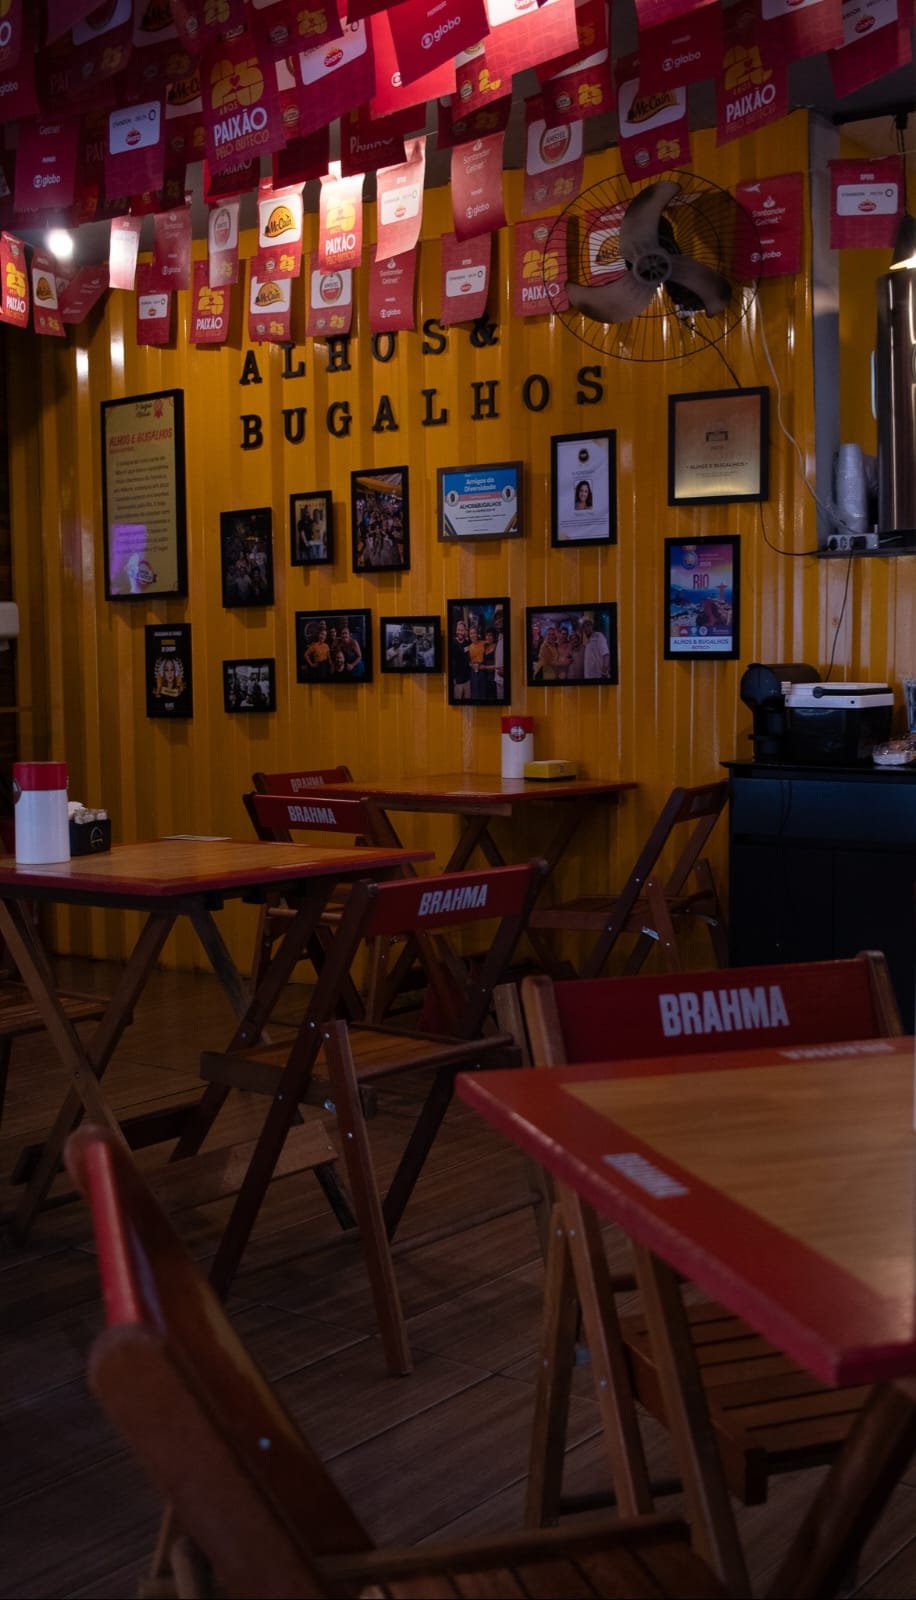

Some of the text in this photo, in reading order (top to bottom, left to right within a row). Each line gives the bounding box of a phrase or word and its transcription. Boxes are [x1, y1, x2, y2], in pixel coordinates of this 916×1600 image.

[433, 16, 461, 42] globo
[673, 51, 702, 68] globo
[208, 57, 264, 110] 25
[577, 83, 604, 107] 25
[635, 93, 672, 115] McCain
[726, 84, 776, 123] PAIXÃO
[213, 107, 268, 147] PAIXÃO
[463, 149, 491, 164] Santander
[655, 138, 681, 162] 25
[42, 173, 61, 188] globo
[553, 178, 574, 197] 25
[473, 203, 490, 217] globo
[751, 208, 784, 218] Santander
[269, 217, 292, 234] McCain
[325, 234, 356, 255] PAIXÃO
[279, 254, 295, 272] 25
[522, 249, 560, 281] 25
[761, 251, 780, 262] globo
[5, 261, 26, 297] 25
[197, 286, 225, 315] 25
[260, 289, 283, 304] McCain
[521, 283, 560, 302] PAIXÃO
[6, 296, 26, 313] PAIXÃO
[196, 315, 223, 331] PAIXÃO
[269, 321, 284, 336] 25
[329, 315, 345, 329] 25
[240, 365, 604, 450] BUGALHOS
[692, 574, 710, 590] RIO
[289, 775, 325, 792] BRAHMA
[287, 805, 337, 825] BRAHMA
[417, 883, 489, 917] BRAHMA
[657, 985, 791, 1038] BRAHMA
